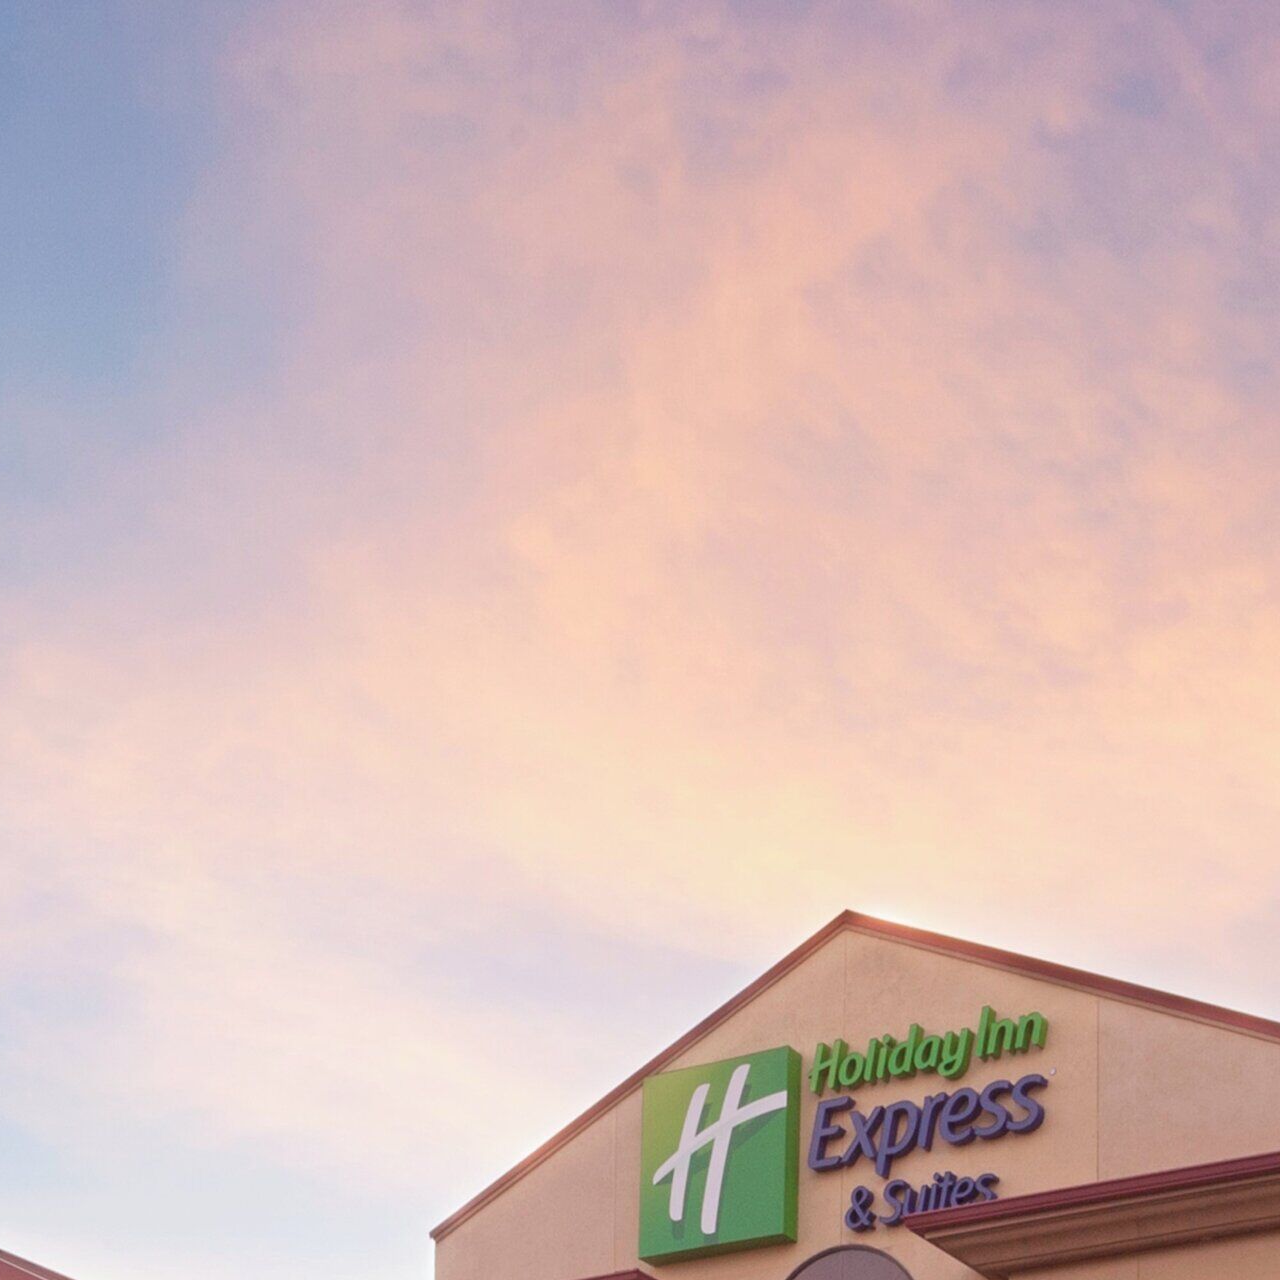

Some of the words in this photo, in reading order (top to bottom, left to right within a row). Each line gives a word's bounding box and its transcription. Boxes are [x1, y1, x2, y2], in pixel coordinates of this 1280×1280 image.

[809, 1022, 975, 1096] Holiday
[975, 1004, 1049, 1062] Inn
[652, 1062, 788, 1236] H
[806, 1073, 1049, 1180] Express
[845, 1185, 877, 1233] &
[879, 1170, 1000, 1227] Suites
